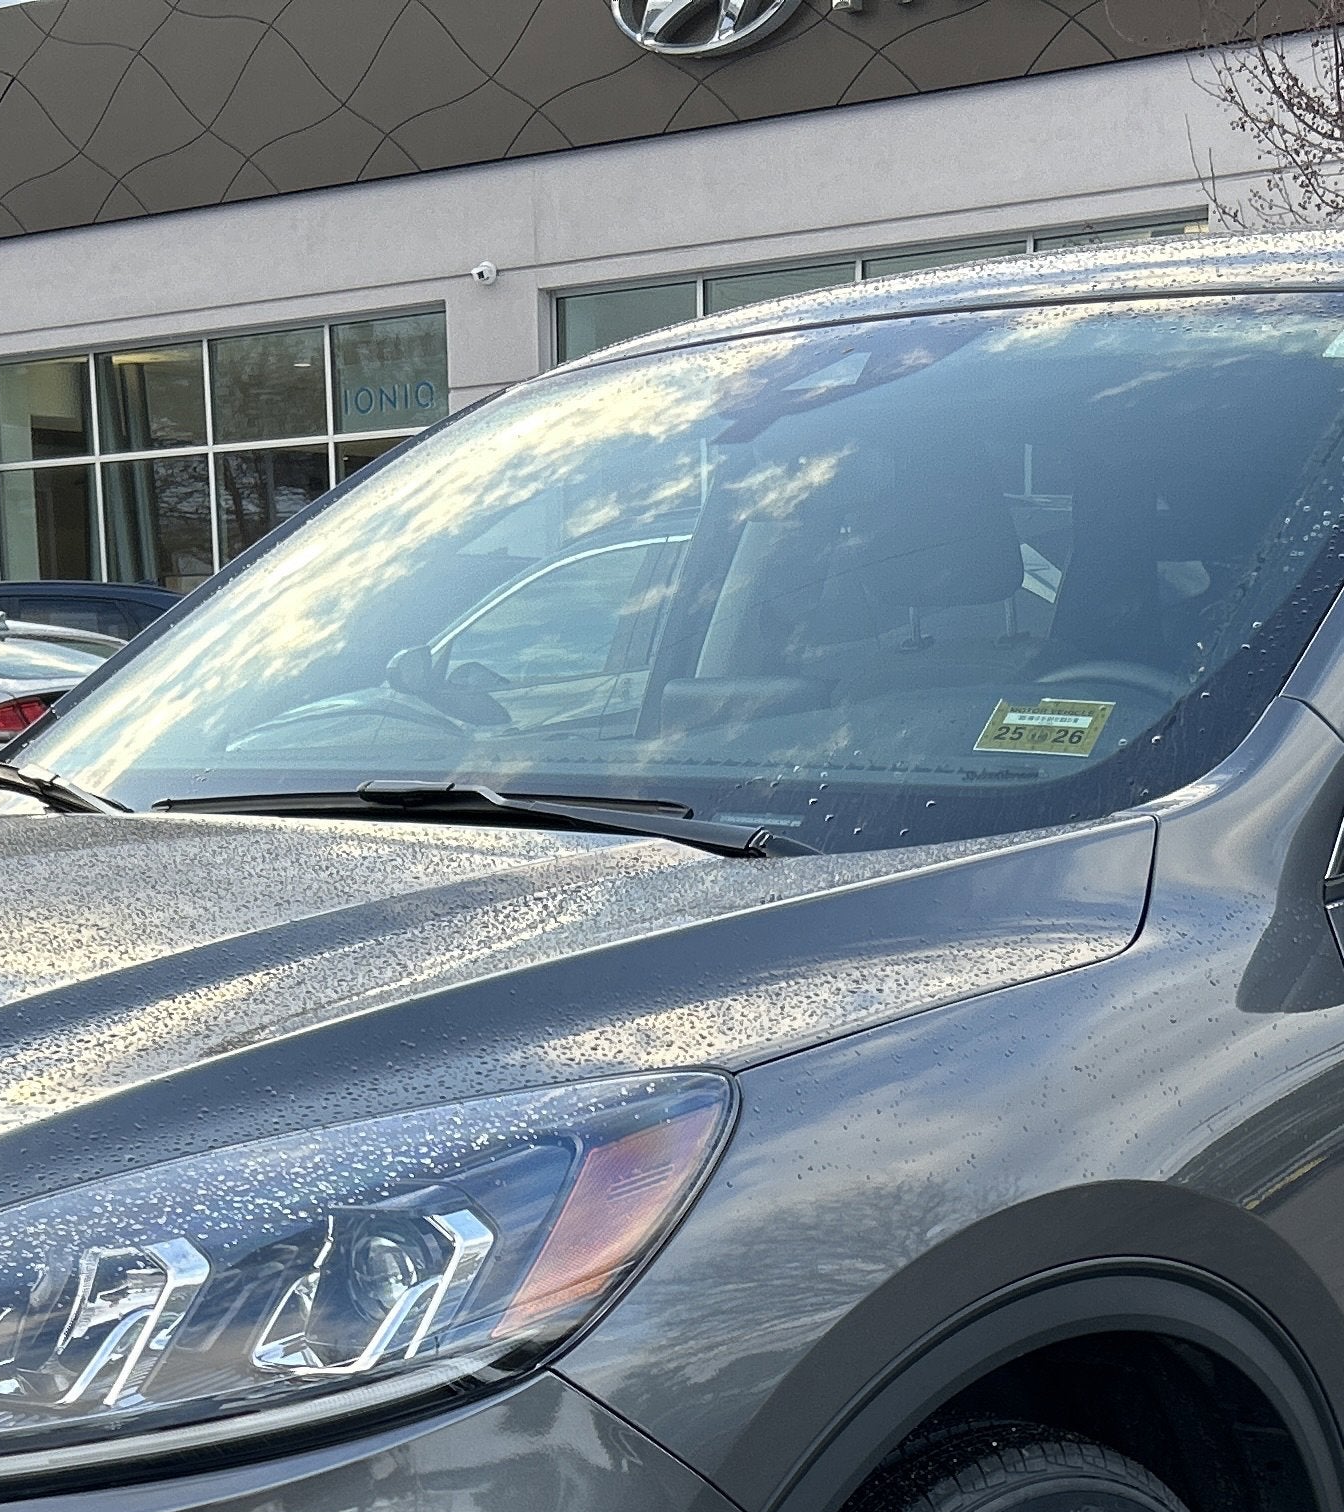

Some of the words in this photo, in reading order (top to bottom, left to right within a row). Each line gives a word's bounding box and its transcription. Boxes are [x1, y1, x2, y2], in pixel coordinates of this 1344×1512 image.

[344, 380, 436, 416] IONIQ
[1049, 708, 1095, 716] VEHICLE
[993, 726, 1027, 741] 25
[1051, 729, 1085, 745] 26
